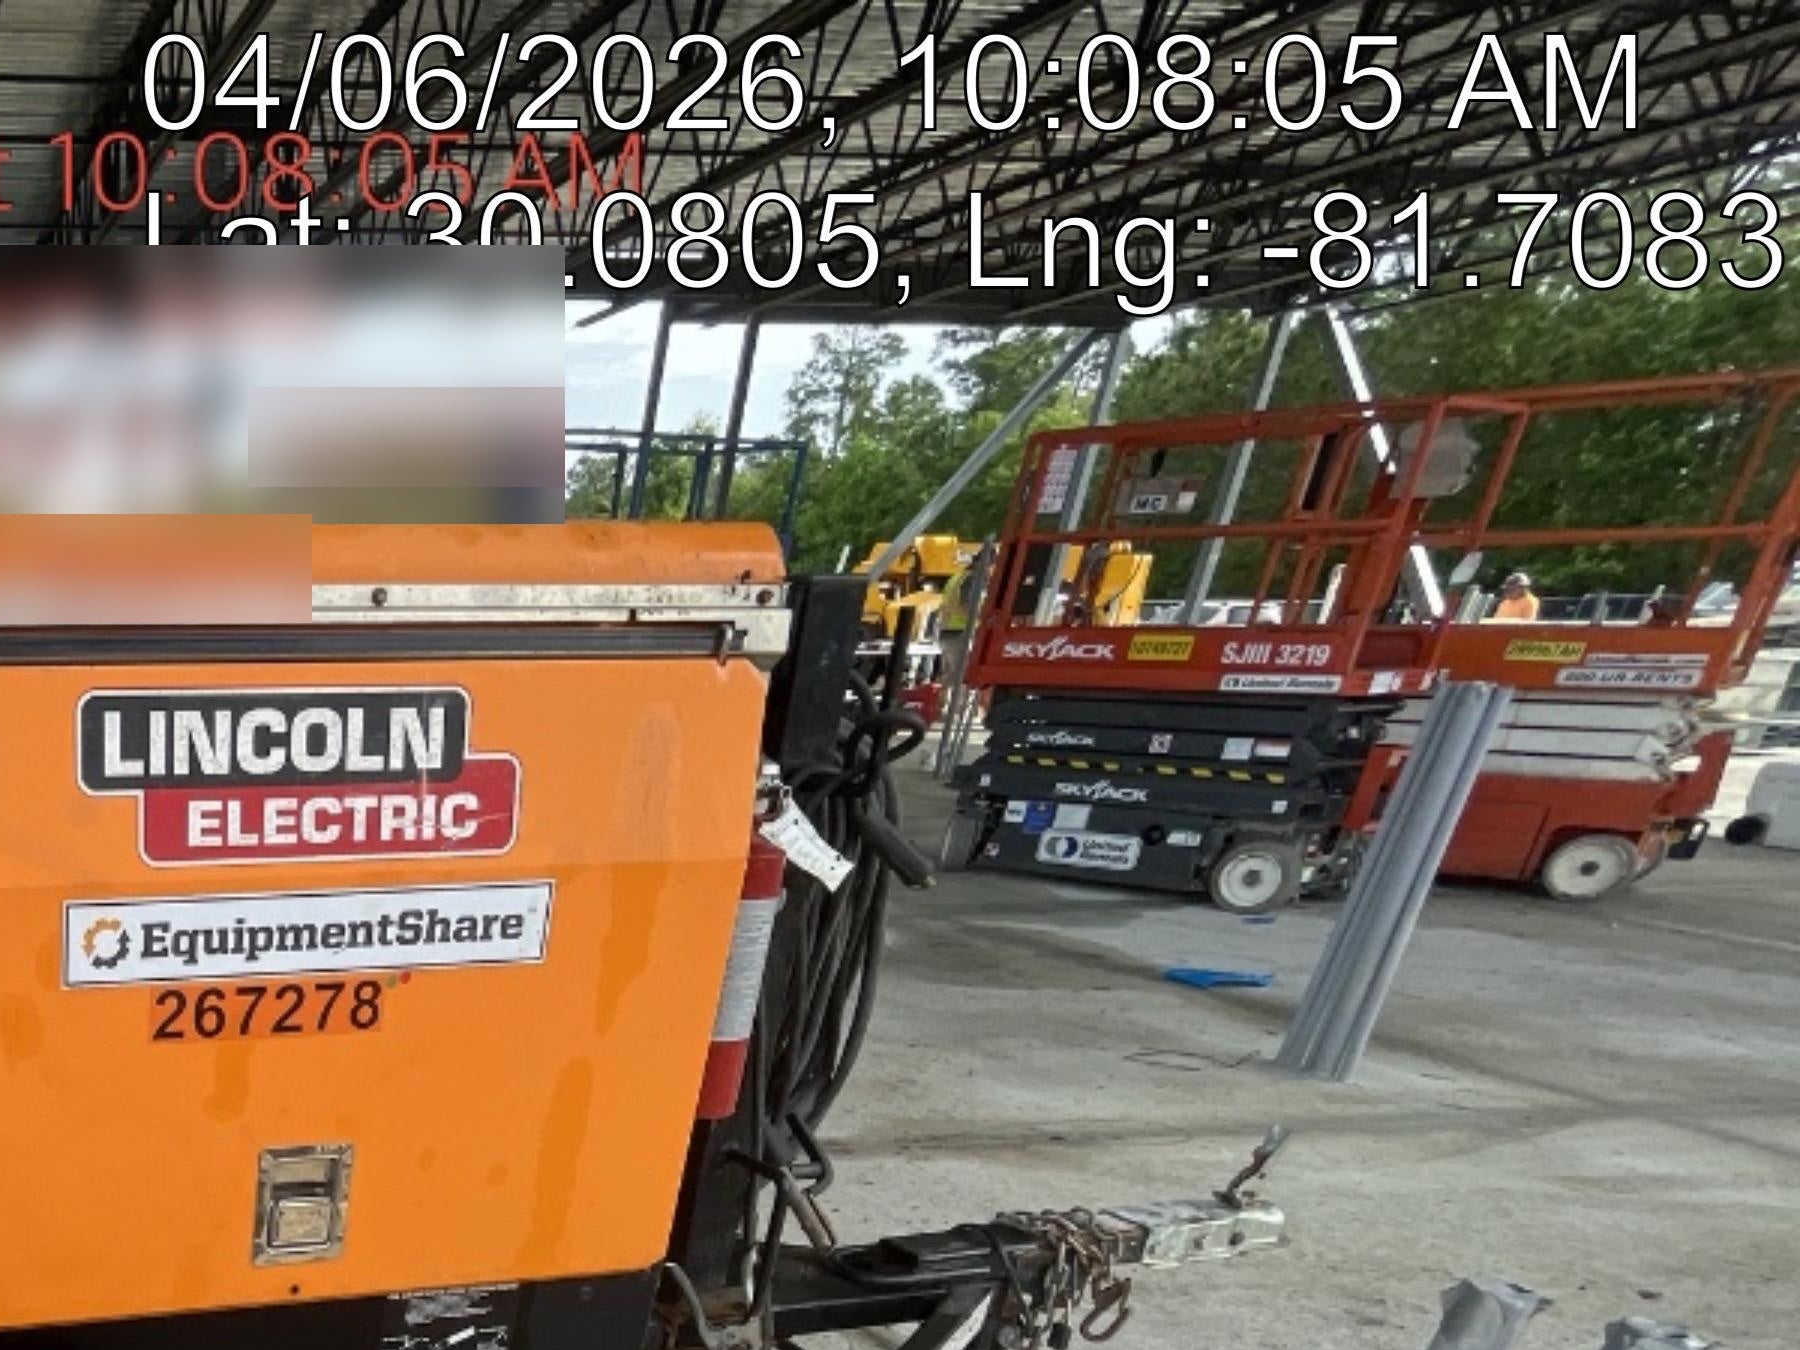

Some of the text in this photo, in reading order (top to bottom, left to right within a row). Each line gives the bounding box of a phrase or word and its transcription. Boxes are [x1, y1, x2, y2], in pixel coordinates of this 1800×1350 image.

[1002, 635, 1114, 661] SKYJACK
[1274, 643, 1331, 667] 3219
[102, 706, 445, 778] LINCOLN
[1054, 779, 1148, 802] SKYJACK
[187, 792, 480, 848] ELECTRIC
[139, 908, 524, 964] EquipmentShare
[152, 978, 384, 1042] 267278
